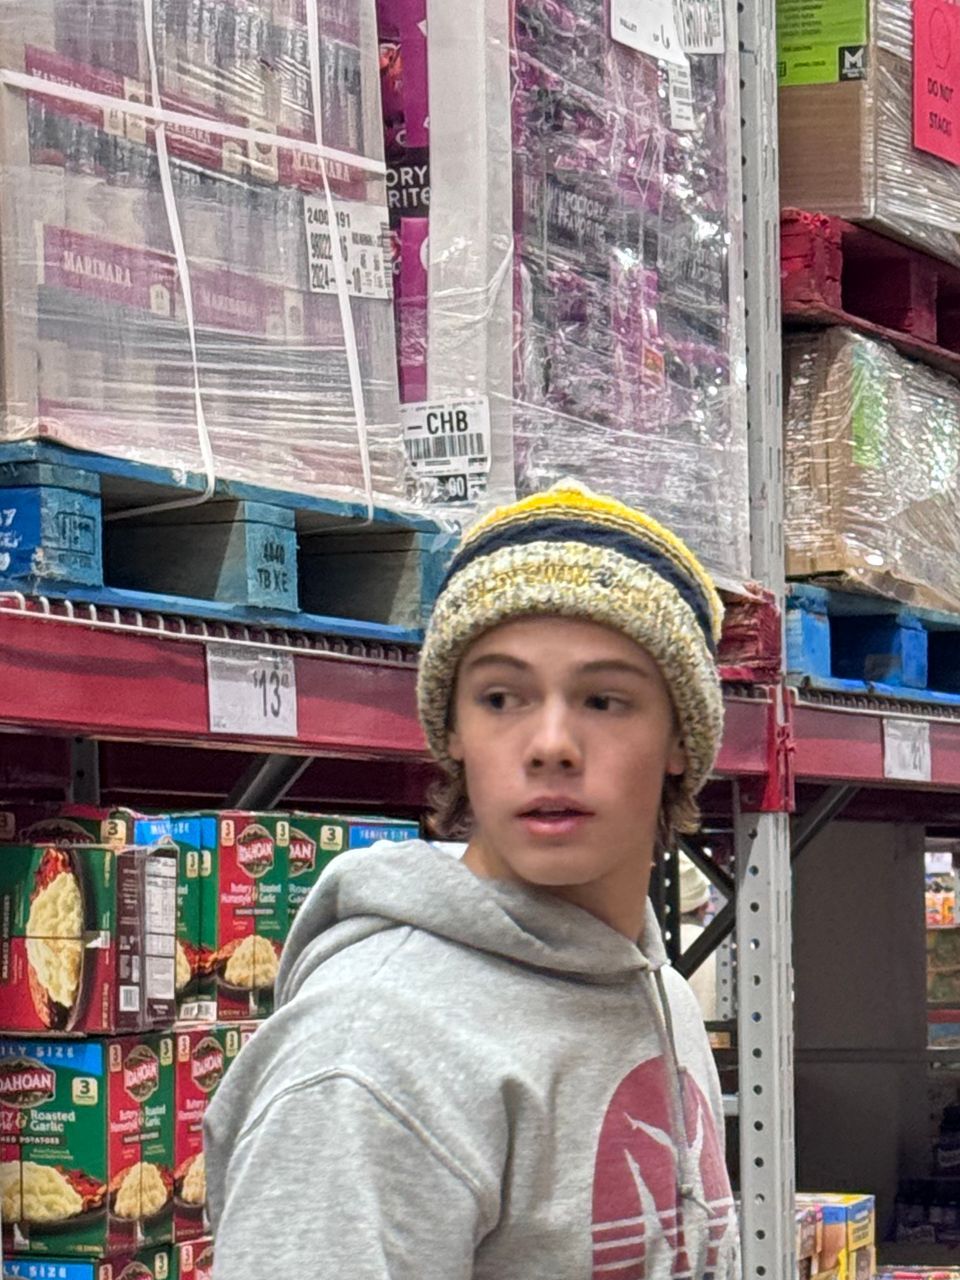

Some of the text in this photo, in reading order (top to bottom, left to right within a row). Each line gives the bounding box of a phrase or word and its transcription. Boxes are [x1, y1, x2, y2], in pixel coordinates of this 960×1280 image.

[927, 77, 939, 97] DO
[63, 250, 132, 288] MARINARA
[426, 410, 469, 435] CHB
[108, 821, 119, 837] 3
[326, 826, 337, 842] 3
[79, 1079, 90, 1094] 3
[31, 1110, 75, 1123] Roasted
[30, 1121, 65, 1133] Garlic
